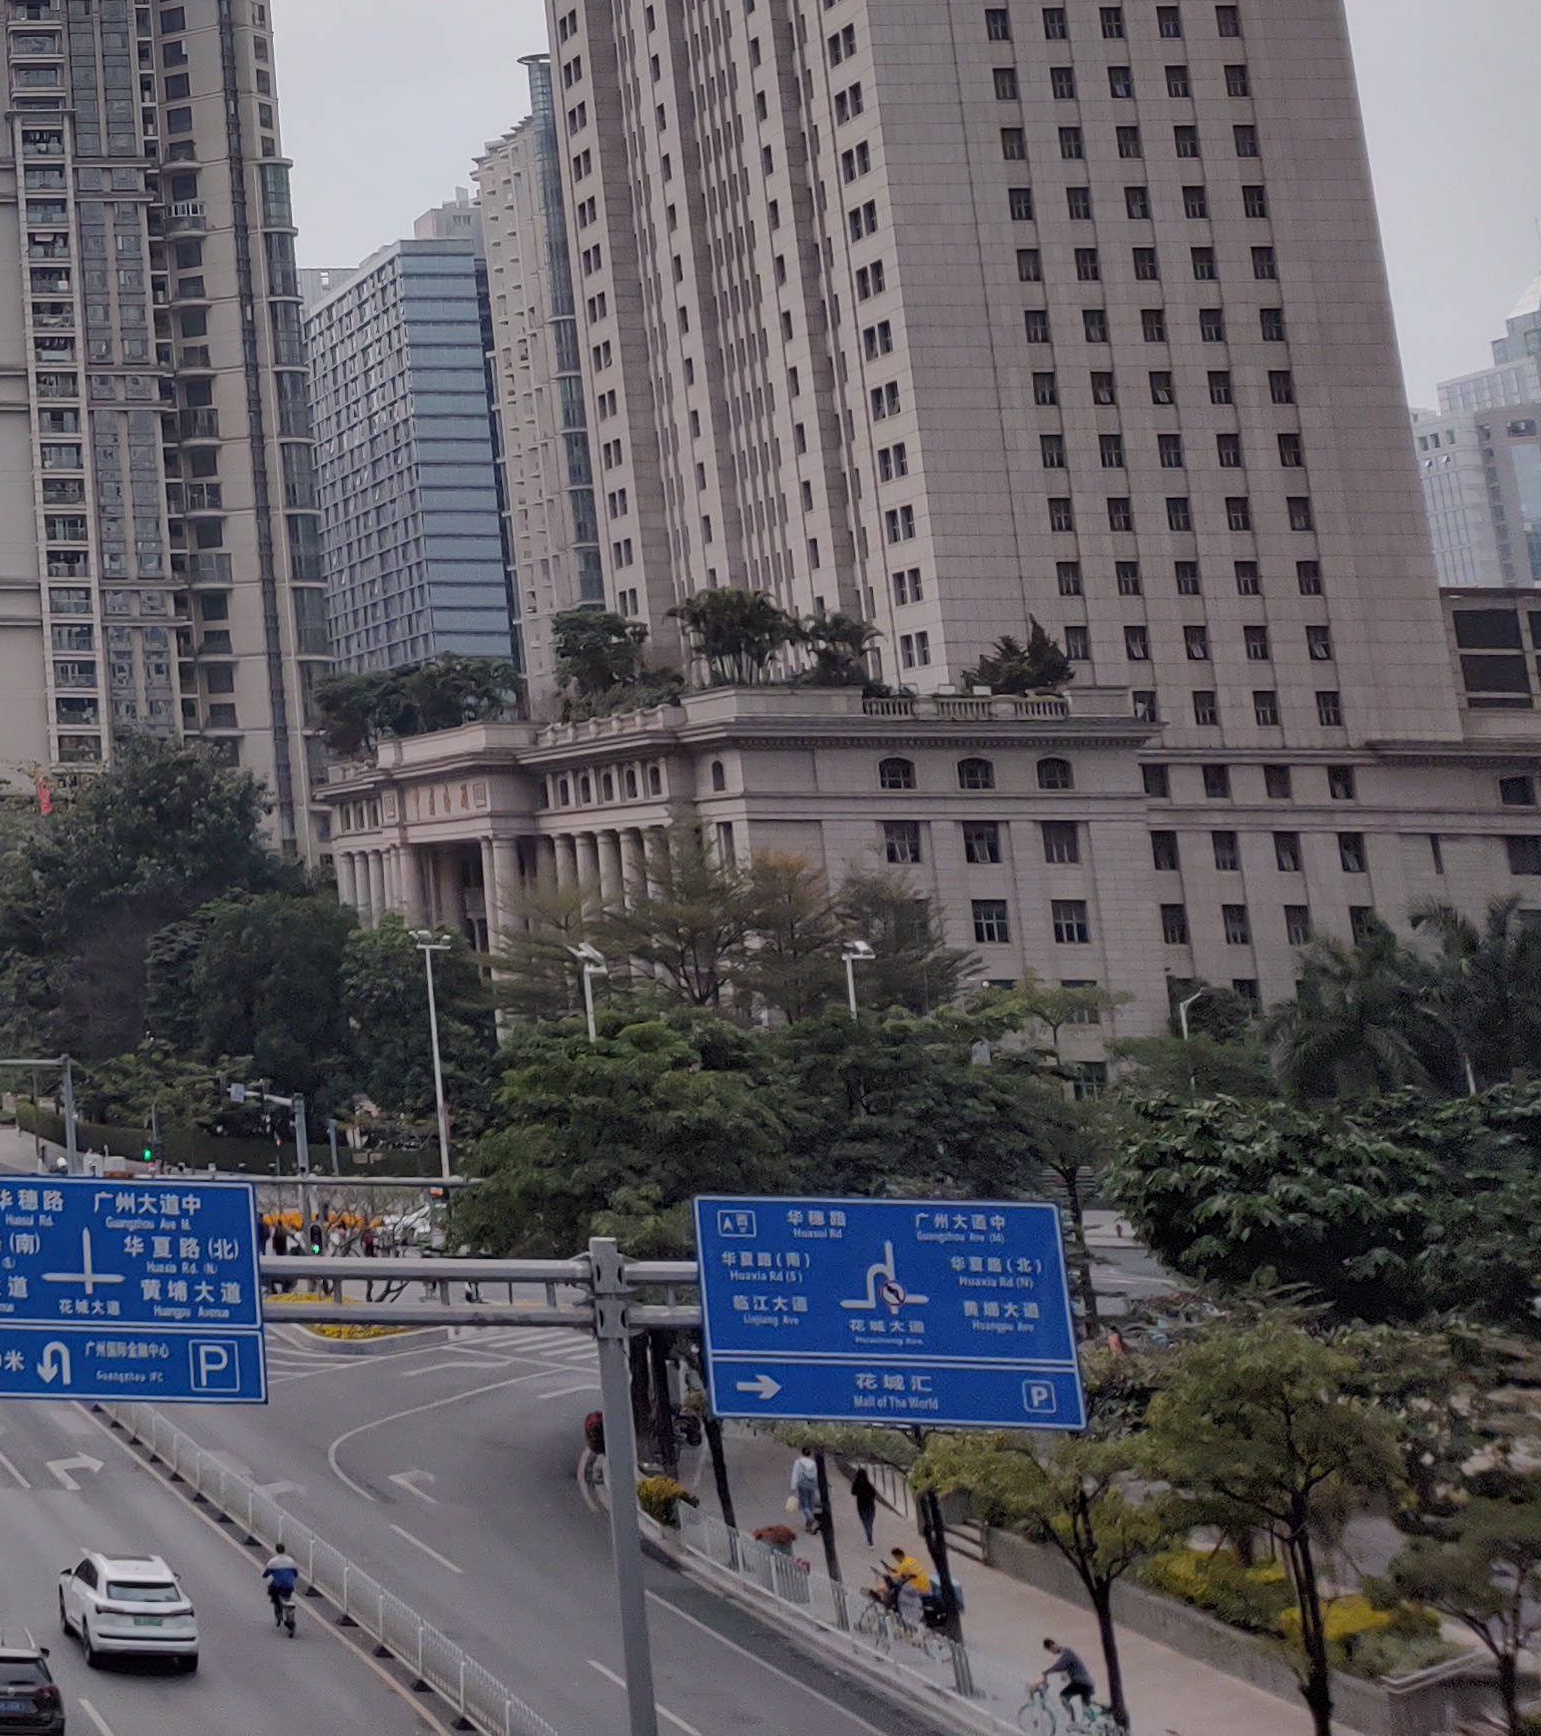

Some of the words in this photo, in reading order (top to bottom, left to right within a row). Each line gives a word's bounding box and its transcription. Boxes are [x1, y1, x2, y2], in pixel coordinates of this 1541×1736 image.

[94, 1191, 201, 1216] 广州大道中
[105, 1215, 155, 1232] Guangzhou
[915, 1212, 1005, 1231] 广州大道中
[793, 1227, 828, 1238] Huasui
[829, 1227, 843, 1239] Rd
[123, 1234, 239, 1260] 华夏路(北)
[730, 1270, 768, 1281] Huaxia
[769, 1270, 783, 1282] Rd
[958, 1275, 997, 1288] Huaxia
[999, 1276, 1014, 1288] Rd
[140, 1279, 242, 1304] 黄埔大道
[59, 1298, 120, 1316] 花城大道
[732, 1294, 808, 1312] 临江大道
[848, 1319, 925, 1334] 花城大道
[85, 1340, 170, 1359] 广州国际金融中心
[199, 1345, 229, 1387] P
[855, 1373, 933, 1392] 花城汇
[853, 1395, 875, 1408] Mall
[877, 1395, 887, 1408] of
[888, 1396, 907, 1409] The
[908, 1396, 939, 1410] World
[1031, 1386, 1048, 1409] P
